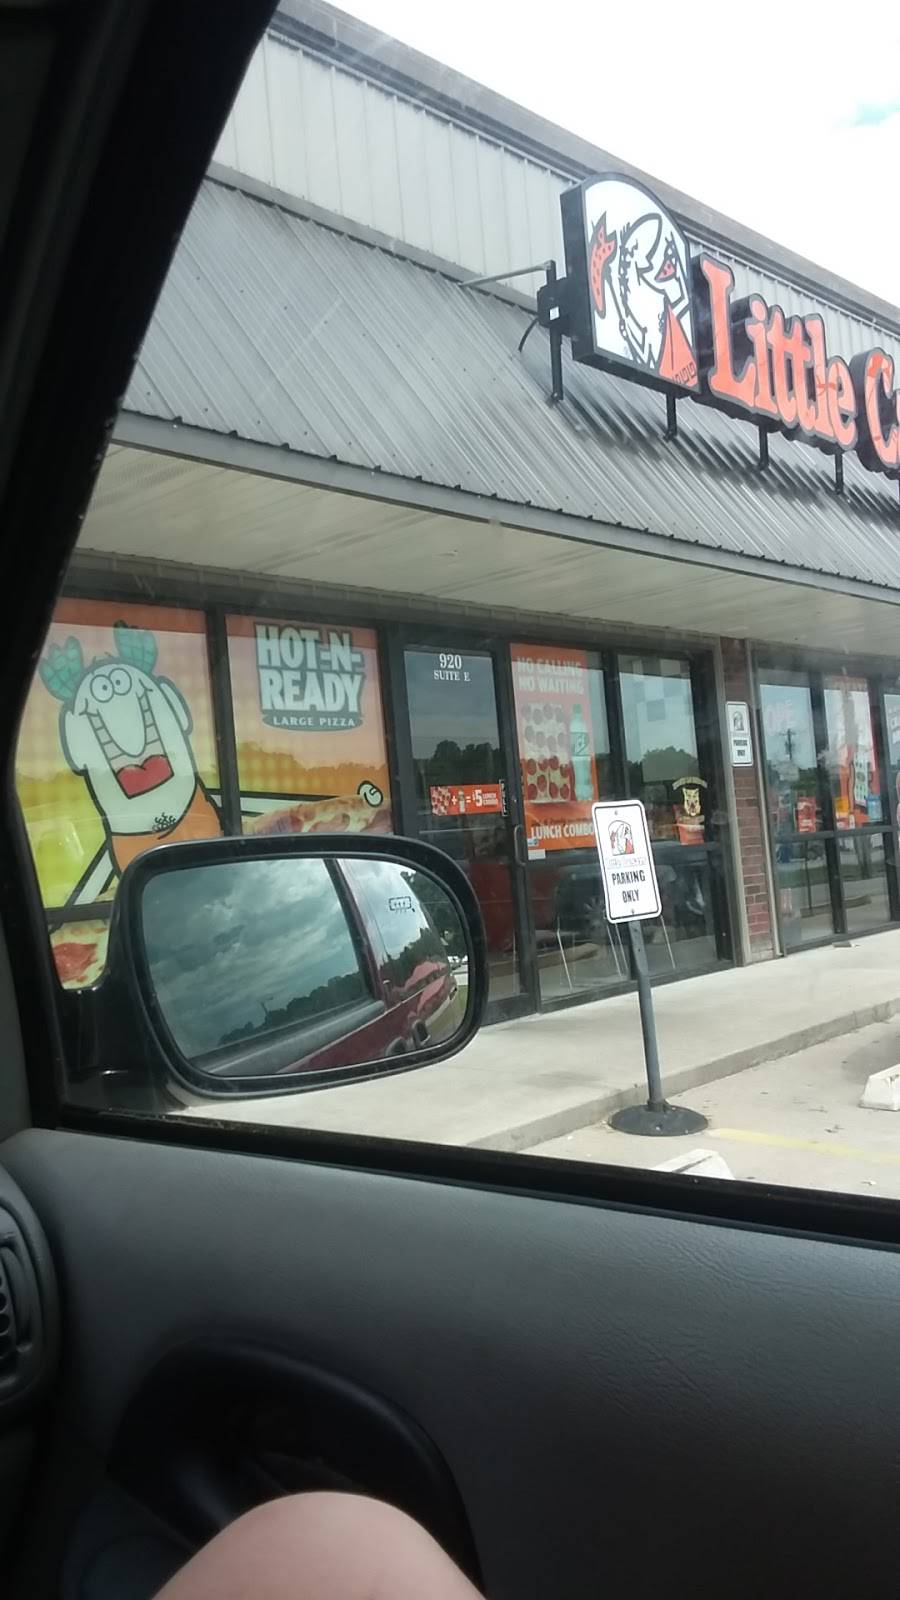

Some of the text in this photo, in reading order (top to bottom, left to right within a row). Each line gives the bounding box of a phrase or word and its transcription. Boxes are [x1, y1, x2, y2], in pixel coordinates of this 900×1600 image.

[701, 255, 857, 449] Little
[439, 652, 462, 670] 920
[516, 656, 583, 678] NO CALLING
[433, 669, 471, 682] SUITE E
[258, 668, 364, 713] READY
[518, 675, 584, 695] NO WAITING
[272, 715, 356, 728] LARGE PIZZA
[531, 825, 562, 840] LUNCH
[611, 869, 646, 886] PARKING
[621, 889, 640, 904] ONLY
